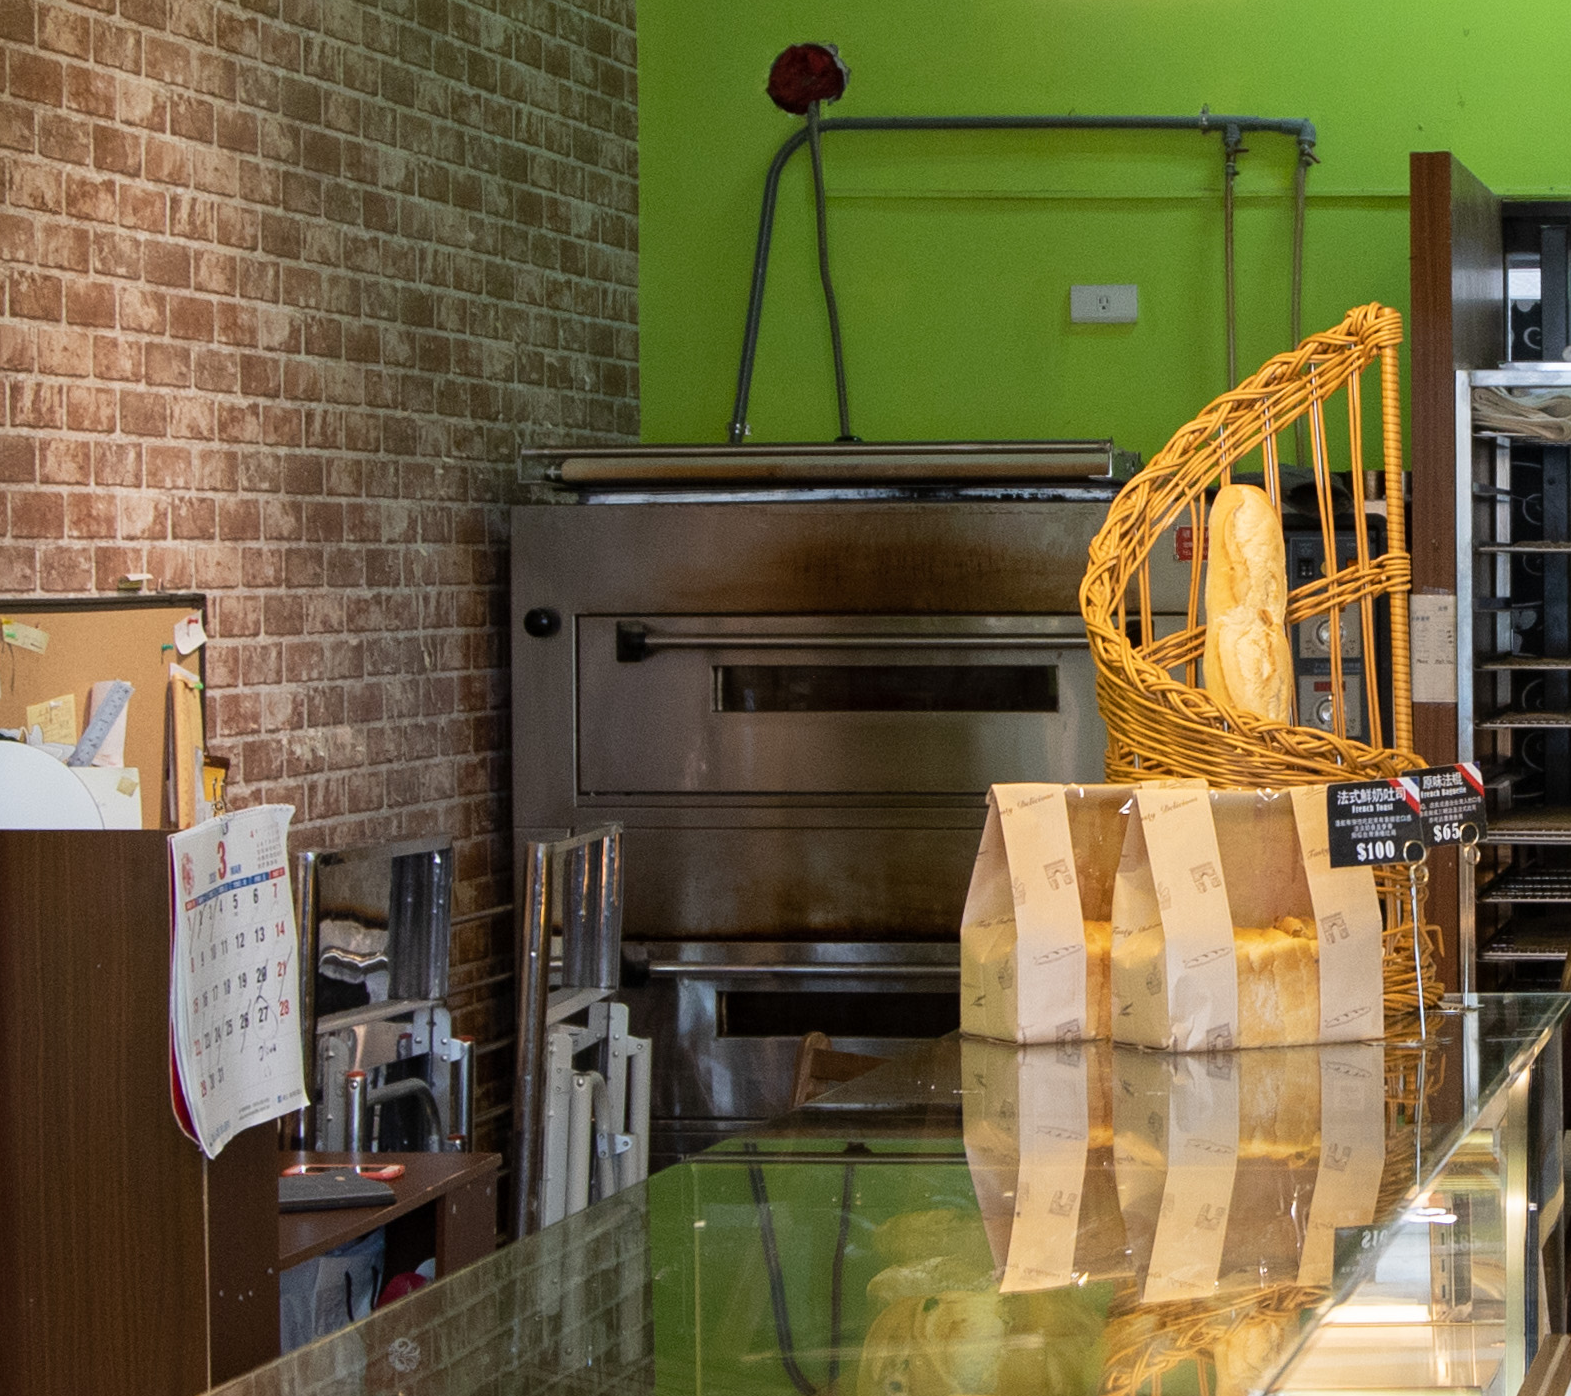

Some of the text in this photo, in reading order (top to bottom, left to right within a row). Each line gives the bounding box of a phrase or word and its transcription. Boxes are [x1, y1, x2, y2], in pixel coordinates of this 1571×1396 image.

[1336, 786, 1407, 806] 法式鮮奶吐司
[1432, 821, 1460, 844] $65
[216, 840, 228, 881] 3
[1355, 839, 1396, 862] $100
[232, 892, 239, 911] 5
[252, 887, 260, 905] 6
[234, 931, 246, 950] 12
[254, 925, 266, 944] 13
[274, 919, 286, 938] 14
[237, 971, 248, 989] 19
[257, 1005, 269, 1024] 27
[278, 998, 290, 1017] 28
